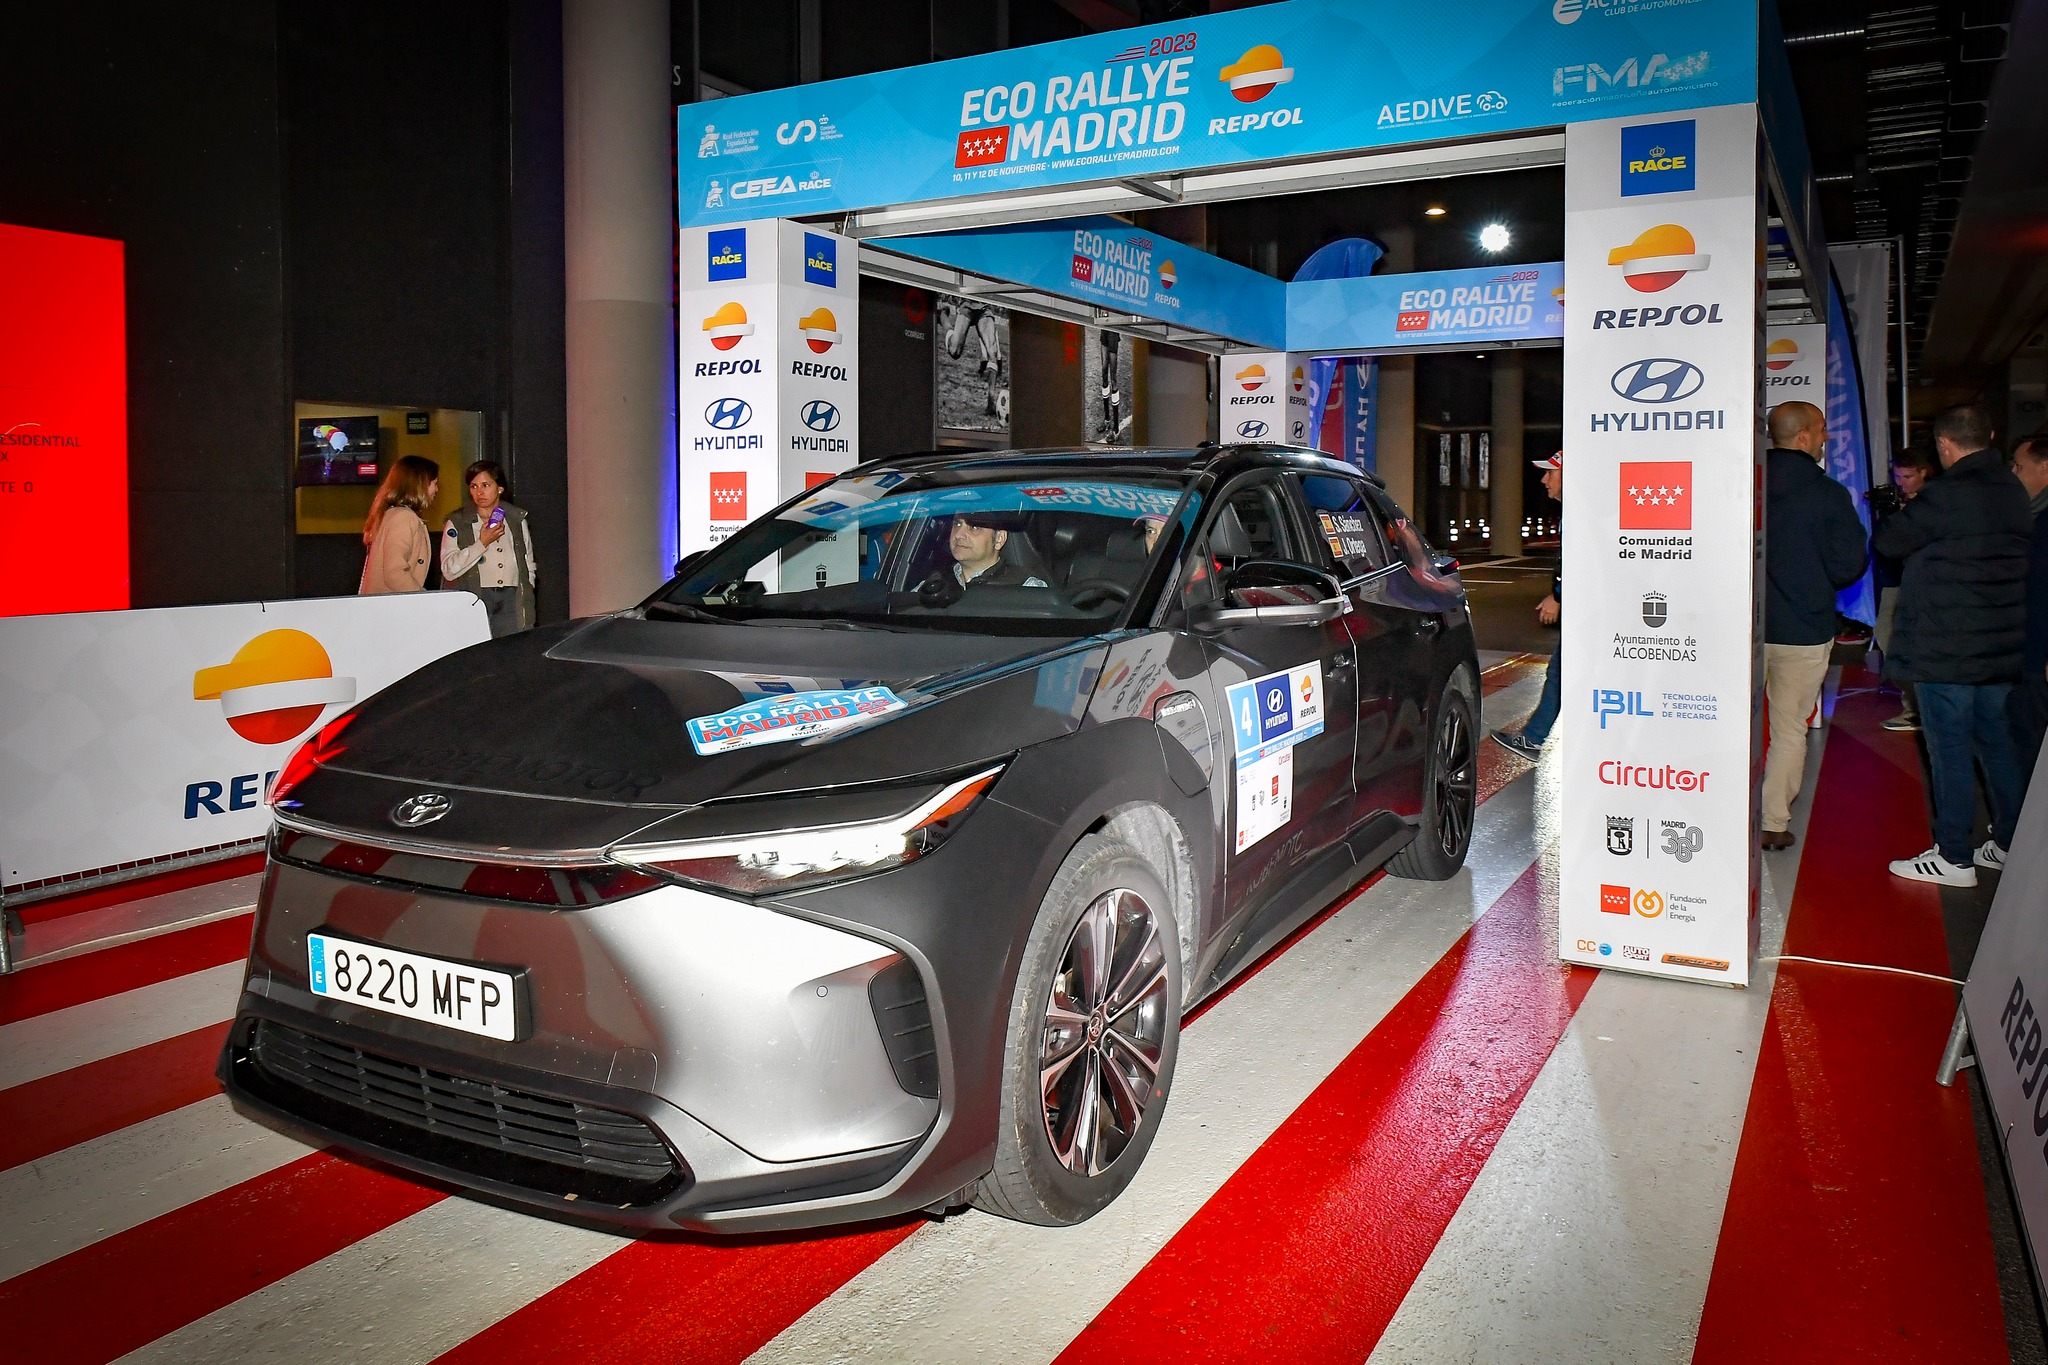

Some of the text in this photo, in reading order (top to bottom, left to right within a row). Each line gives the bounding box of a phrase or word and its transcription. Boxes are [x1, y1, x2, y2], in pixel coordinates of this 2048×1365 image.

[1604, 6, 1626, 17] CLUB
[1627, 4, 1639, 13] DE
[1149, 32, 1198, 57] 2023
[960, 56, 1194, 127] ECO RALLYE
[1377, 93, 1472, 125] AEDIVE
[1010, 101, 1186, 161] MADRID
[1207, 107, 1303, 136] REPSOL
[734, 129, 759, 139] Federación
[952, 145, 1180, 183] 10, 11 Y 12 DE NOVIEMBRE WWW.ECORALLYEMADRID.COM
[1629, 155, 1687, 174] RACE
[730, 175, 831, 200] CEEA RACE
[712, 253, 742, 265] RACE
[1073, 229, 1152, 275] ECO RALLYE
[807, 257, 833, 272] RACE
[1092, 261, 1149, 299] MADRID
[1511, 270, 1540, 281] 2023
[1154, 292, 1181, 308] REPSOL
[1400, 282, 1538, 311] ECO RALLYE
[1430, 304, 1533, 330] MADRID
[1592, 303, 1723, 330] REPSOL
[694, 358, 762, 377] REPSOL
[791, 360, 848, 381] REPSOL
[1230, 395, 1276, 405] REPSOL
[1591, 410, 1724, 432] HYUNDAI
[694, 434, 763, 451] HYUNDAI
[791, 436, 849, 453] HYUNDAI
[1618, 535, 1693, 546] Comunidad
[1618, 549, 1692, 560] de Madrid
[1613, 632, 1697, 647] Ayuntamiento de
[1613, 646, 1697, 662] ALCOBENDAS
[1662, 692, 1718, 703] TECNOLOGÍA
[1672, 702, 1718, 712] SERVICIOS
[697, 711, 762, 732] ECO
[769, 689, 886, 717] RALLYE
[1241, 697, 1253, 736] 4
[1676, 711, 1717, 721] RECARGA
[703, 705, 849, 743] MADRID
[1265, 711, 1289, 730] HYUNDAI
[1598, 760, 1710, 793] Circutor
[1661, 819, 1686, 829] MADRID
[1660, 826, 1704, 863] 360
[1669, 893, 1707, 905] Fundación
[1669, 903, 1687, 912] de la
[1669, 912, 1696, 923] Energía
[1624, 945, 1650, 956] AUTO
[315, 970, 323, 984] E
[334, 949, 500, 1026] 8220 MFP
[2001, 976, 2048, 1167] REPSO
